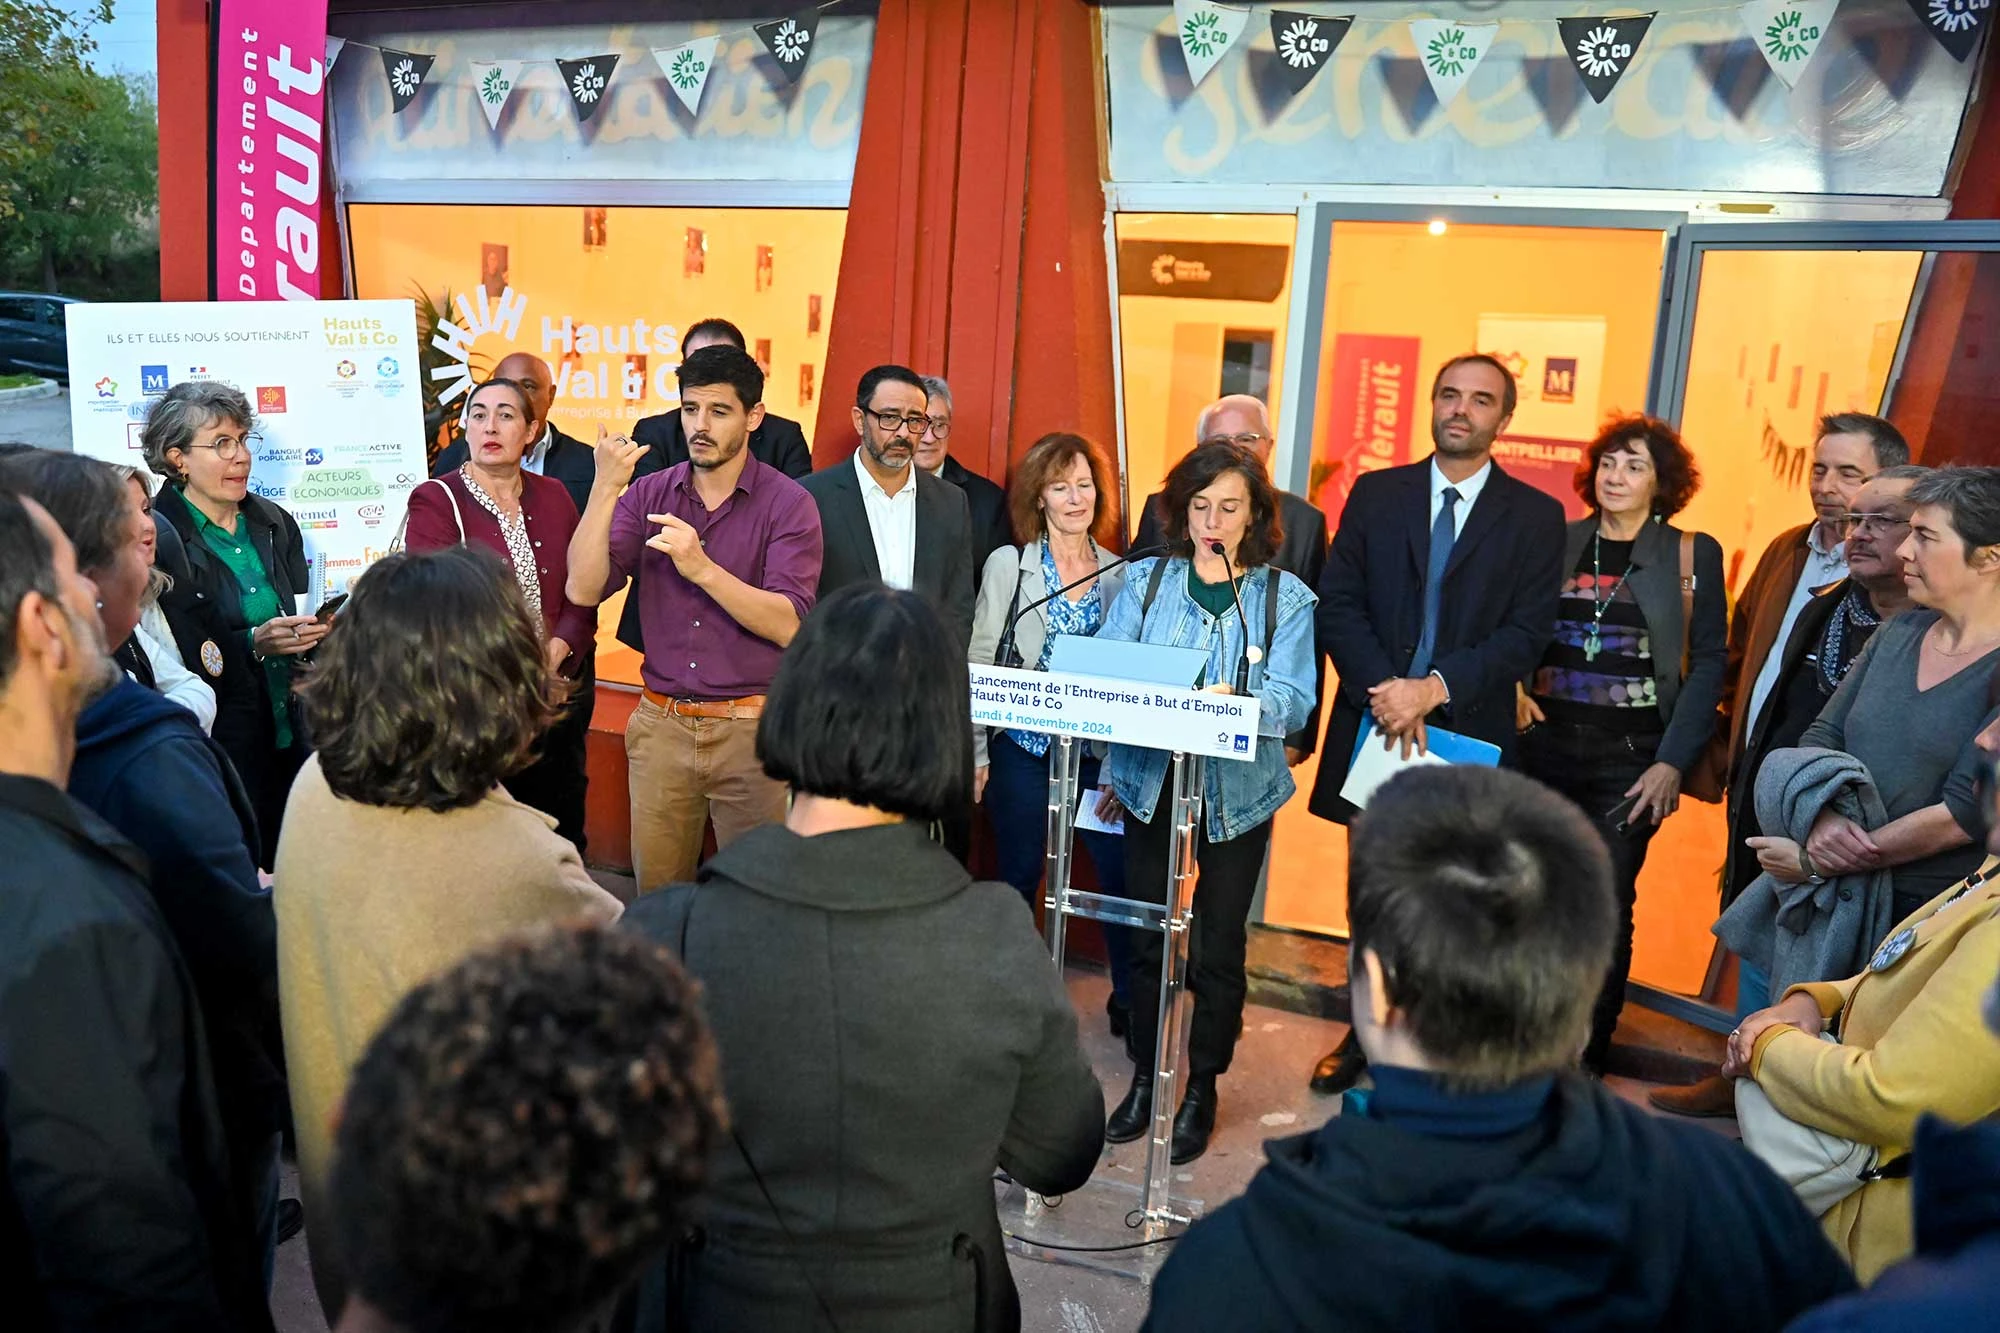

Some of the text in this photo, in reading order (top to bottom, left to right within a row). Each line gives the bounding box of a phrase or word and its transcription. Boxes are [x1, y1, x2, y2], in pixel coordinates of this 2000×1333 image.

[1211, 30, 1227, 44] CO
[1800, 26, 1819, 41] CO
[1310, 38, 1328, 52] CO
[1611, 44, 1631, 58] CO
[1460, 47, 1476, 60] CO
[692, 61, 705, 73] CO
[238, 27, 259, 297] Departement
[265, 43, 324, 301] rault
[323, 317, 382, 330] Hauts
[107, 330, 310, 344] ILS ET ELLES NOUS SOUTIENNENT
[325, 332, 354, 346] Val
[372, 331, 398, 345] Co
[541, 316, 677, 354] Hauts
[622, 362, 643, 400] &
[655, 362, 682, 400] C
[1547, 369, 1571, 392] M
[553, 405, 611, 419] ntreprise
[269, 447, 303, 455] BANQUE
[369, 443, 401, 451] ACTIVE
[1489, 439, 1583, 465] ONTPELLIER
[307, 471, 362, 483] ACTEURS
[262, 487, 286, 497] BGE
[970, 672, 1243, 717] Lancement de l'Entreprise à But d'Emploi
[970, 687, 1063, 710] Hauts Val & Co
[971, 710, 1113, 736] undi 4 novembre 2024
